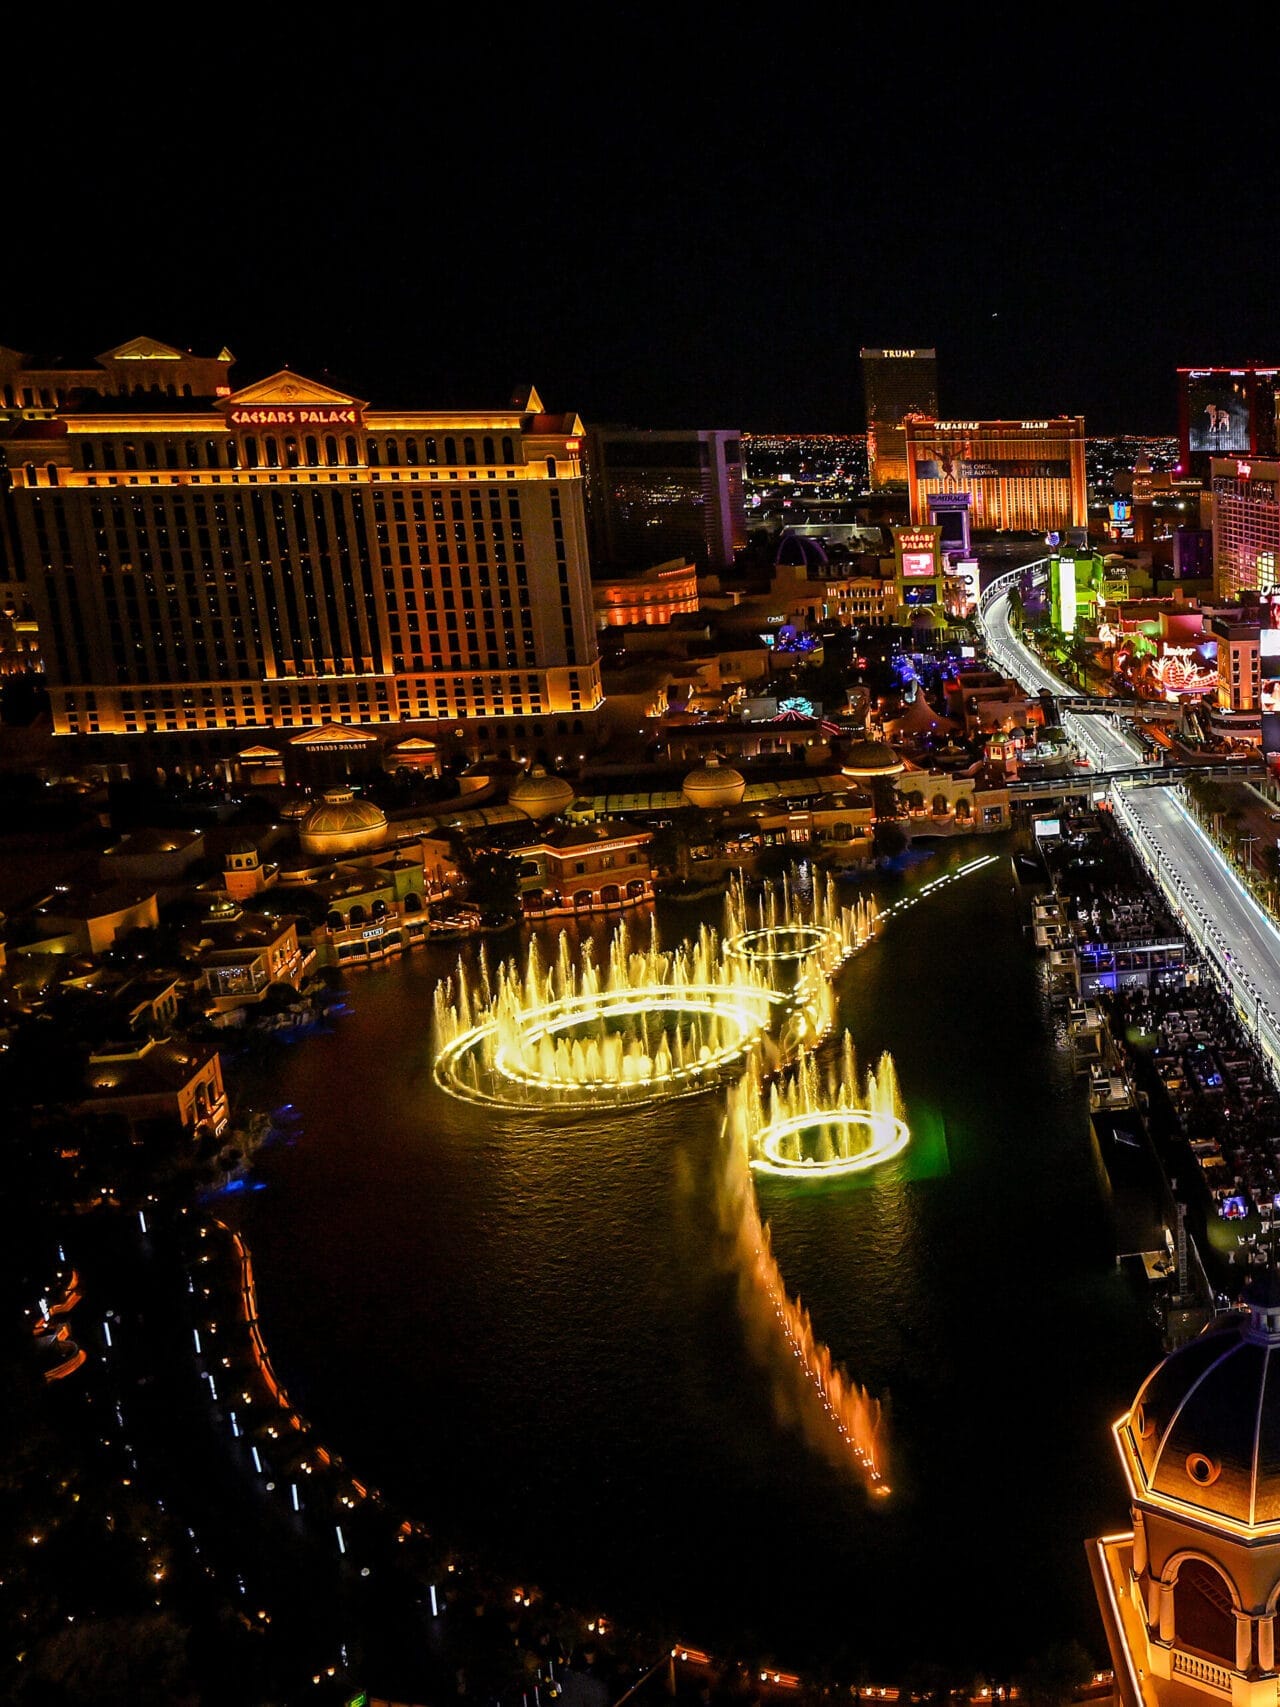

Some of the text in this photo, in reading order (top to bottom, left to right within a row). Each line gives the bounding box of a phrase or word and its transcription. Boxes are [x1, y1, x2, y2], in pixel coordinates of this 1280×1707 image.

[882, 349, 916, 358] TRUMP
[231, 411, 355, 424] CAESARS PALACE
[934, 422, 979, 430] TREASURE
